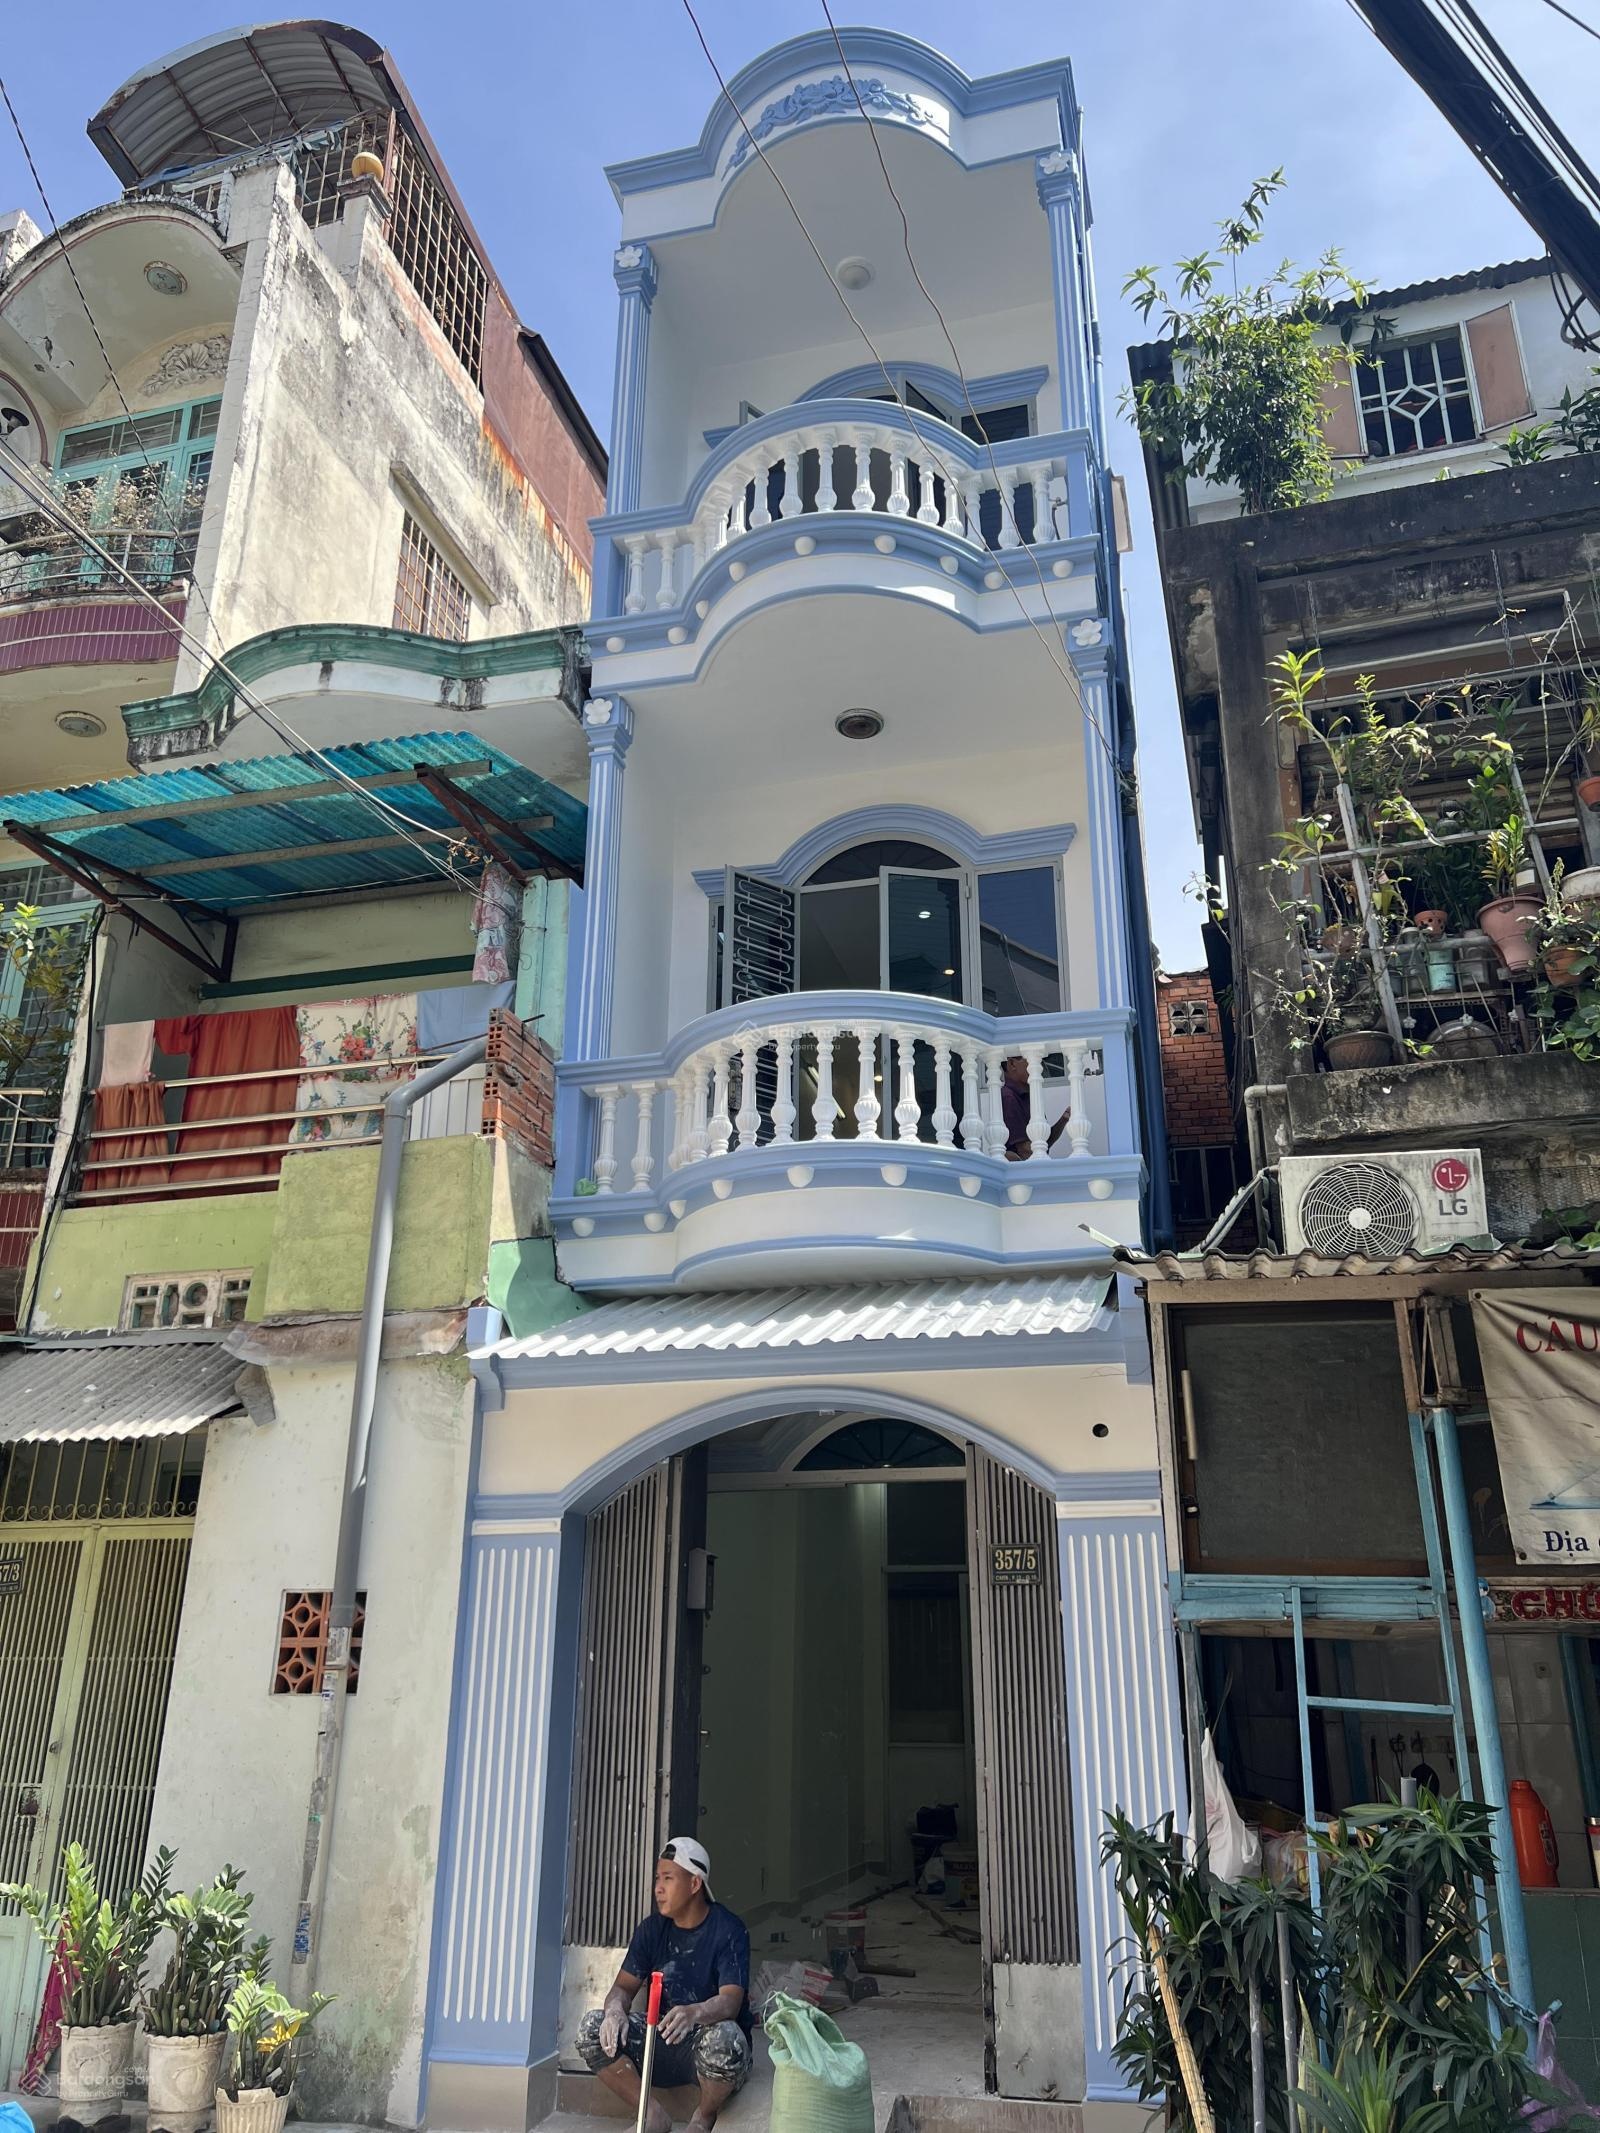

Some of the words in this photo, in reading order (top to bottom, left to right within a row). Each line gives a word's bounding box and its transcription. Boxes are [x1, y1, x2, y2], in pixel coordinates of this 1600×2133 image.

[1438, 1198, 1468, 1216] LG
[1542, 1530, 1590, 1557] Địa
[995, 1548, 1036, 1570] 357/5
